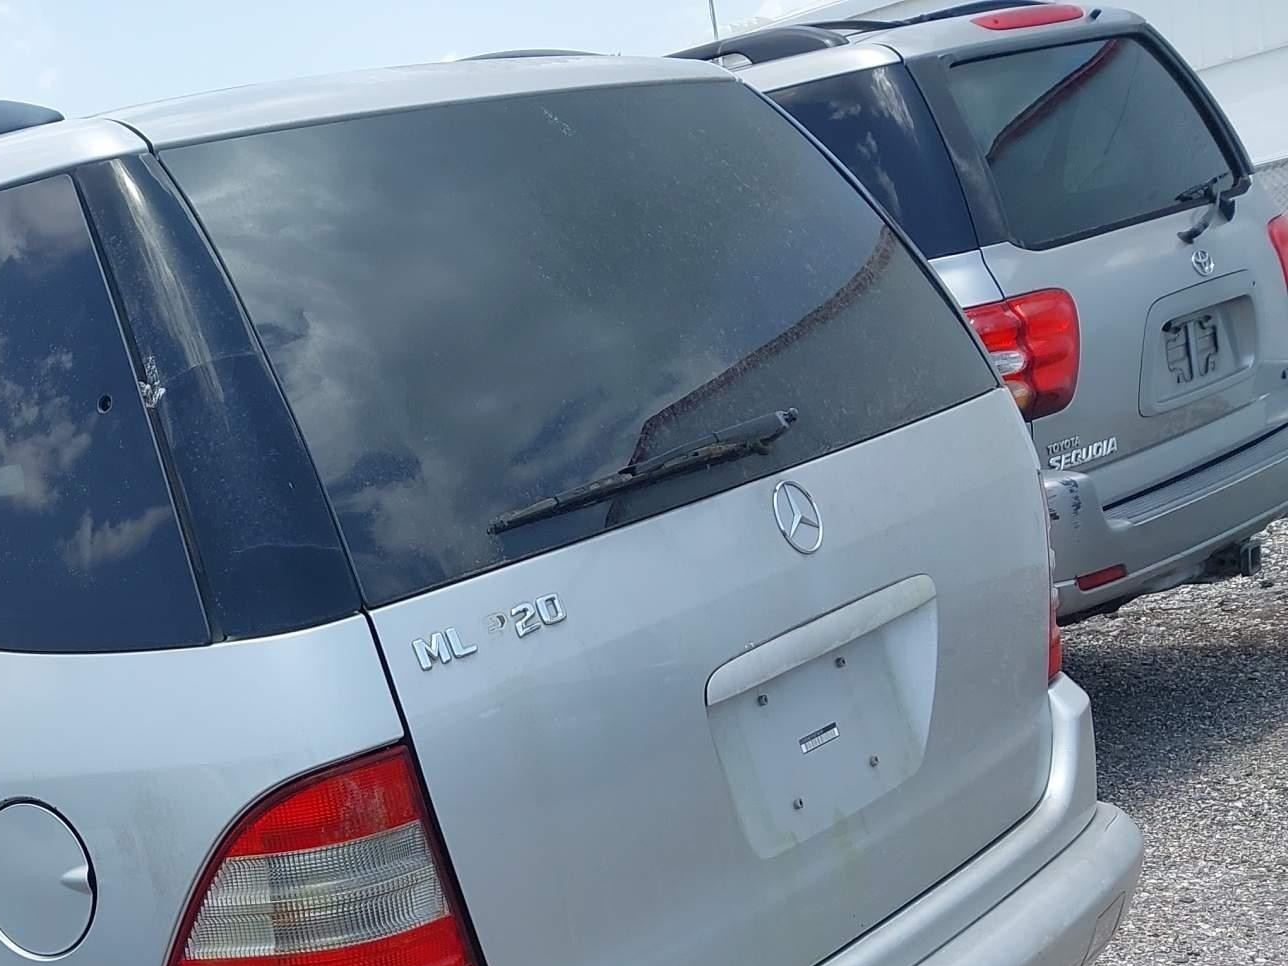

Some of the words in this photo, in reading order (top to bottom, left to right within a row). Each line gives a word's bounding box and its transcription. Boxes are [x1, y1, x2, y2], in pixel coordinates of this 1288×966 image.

[1047, 436, 1080, 455] TOYOTA
[1049, 437, 1118, 470] SEQUOIA
[412, 627, 478, 671] ML
